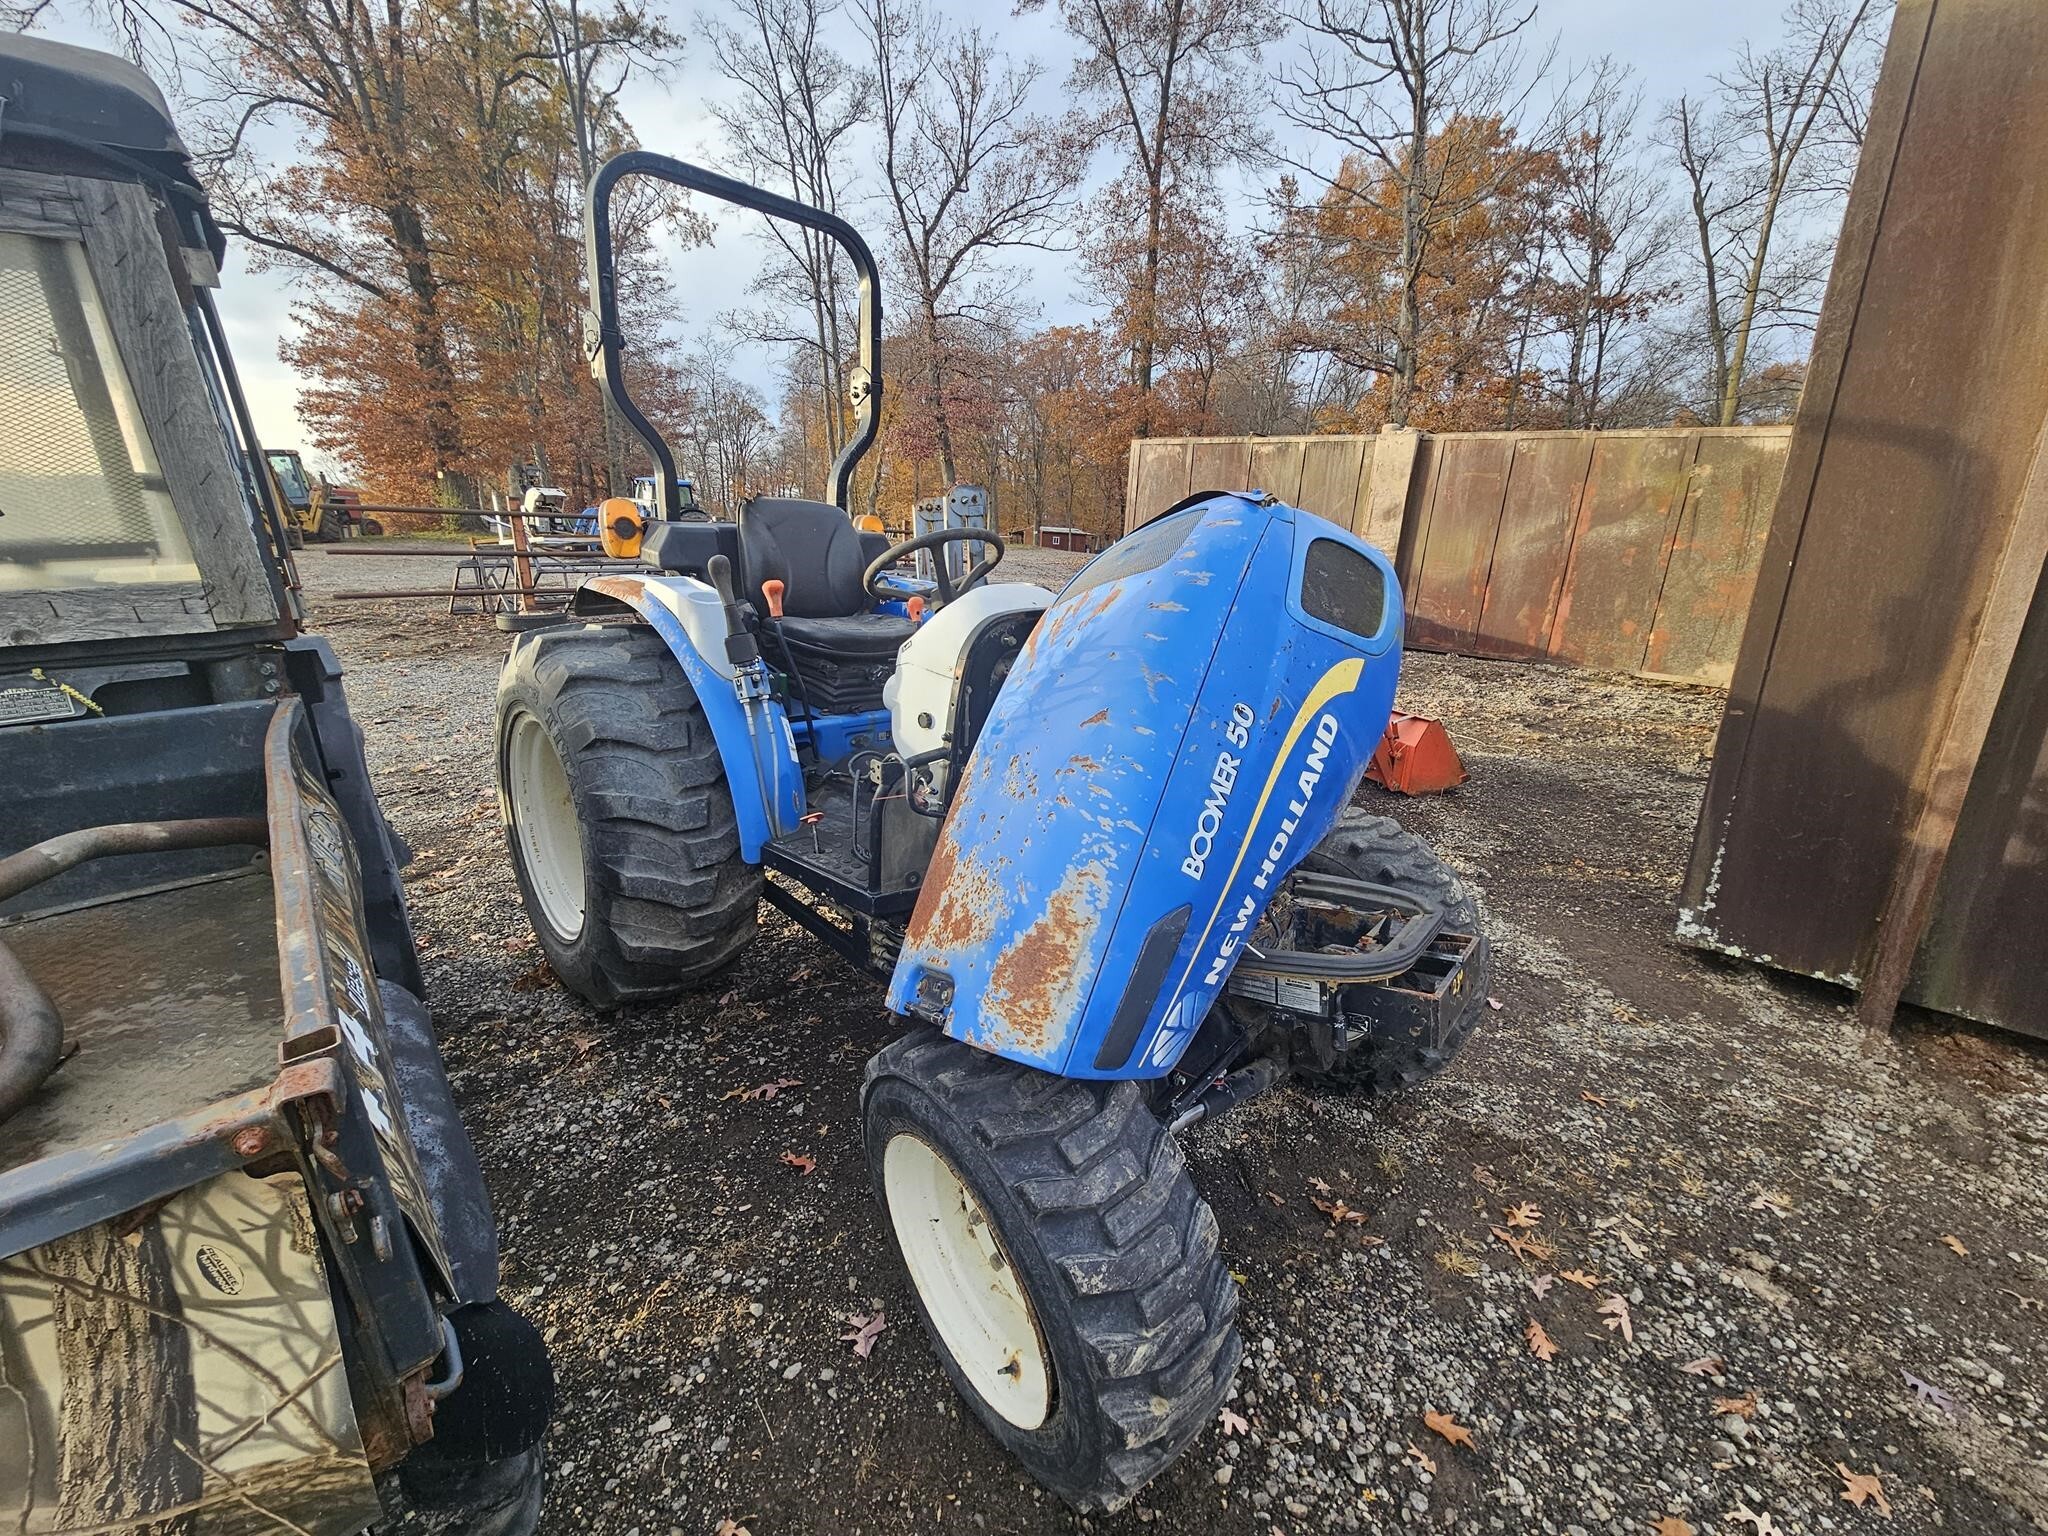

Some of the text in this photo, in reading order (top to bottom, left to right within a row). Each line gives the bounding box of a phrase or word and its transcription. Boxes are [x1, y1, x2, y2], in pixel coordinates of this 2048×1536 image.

[1181, 702, 1256, 881] BOOMER 50
[1204, 713, 1339, 986] NEW HOLLAND
[205, 1247, 240, 1287] REALTREE
